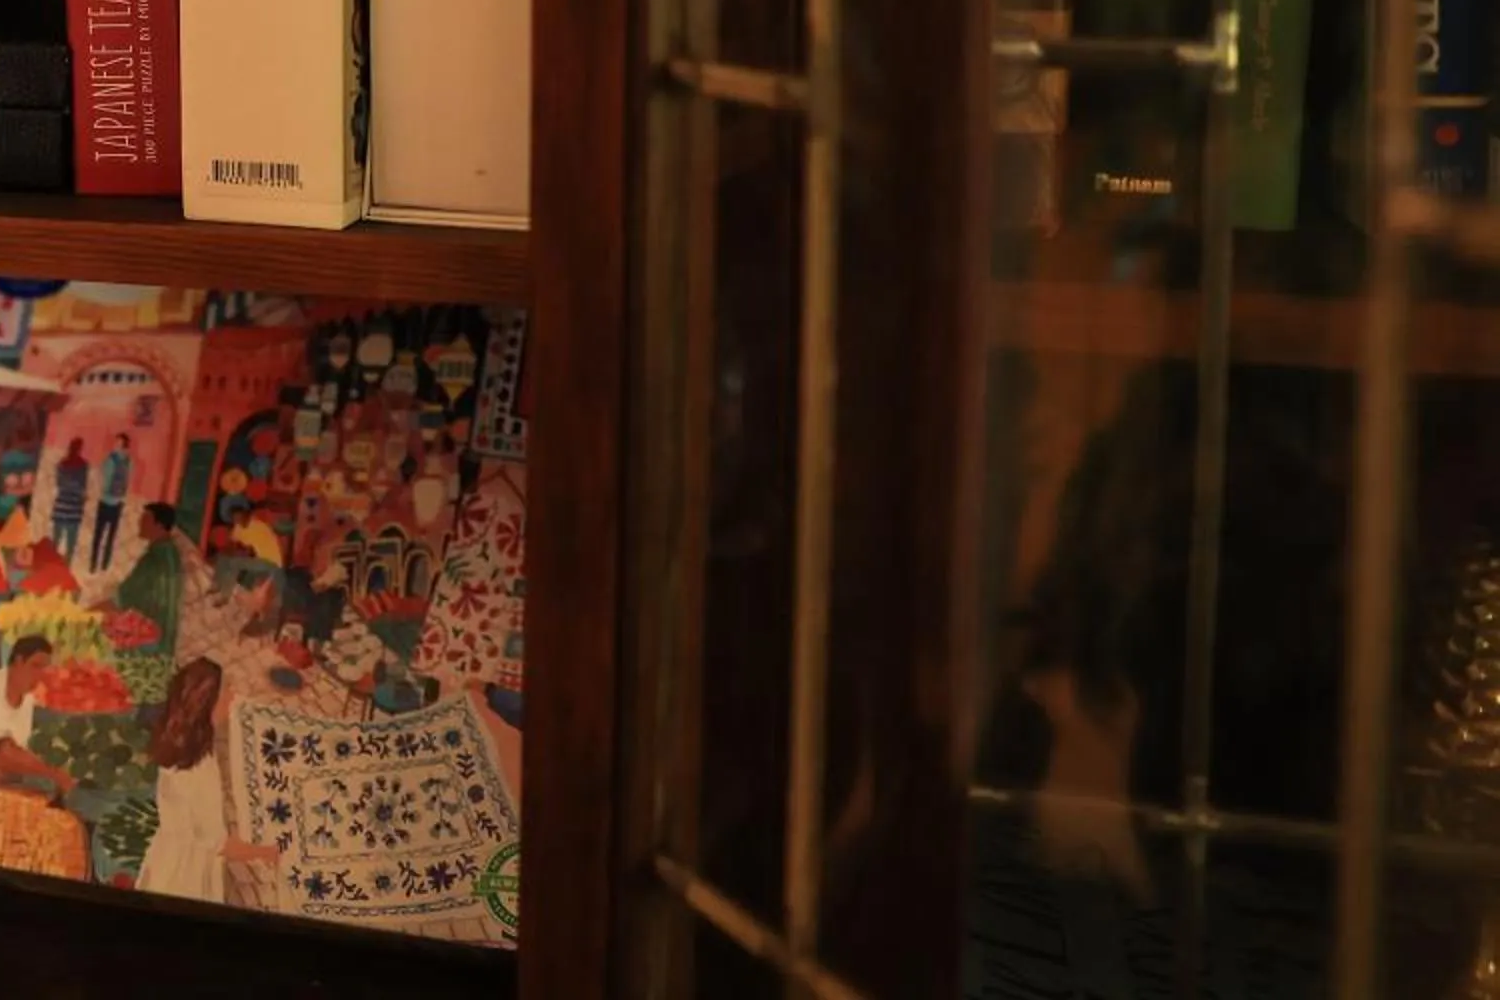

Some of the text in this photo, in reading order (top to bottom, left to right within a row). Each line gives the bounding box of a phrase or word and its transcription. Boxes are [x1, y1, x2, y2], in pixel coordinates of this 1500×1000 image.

[138, 24, 151, 42] BY
[139, 46, 152, 93] PUZZLE
[89, 44, 139, 164] JAPANESE
[142, 97, 155, 137] PIECE
